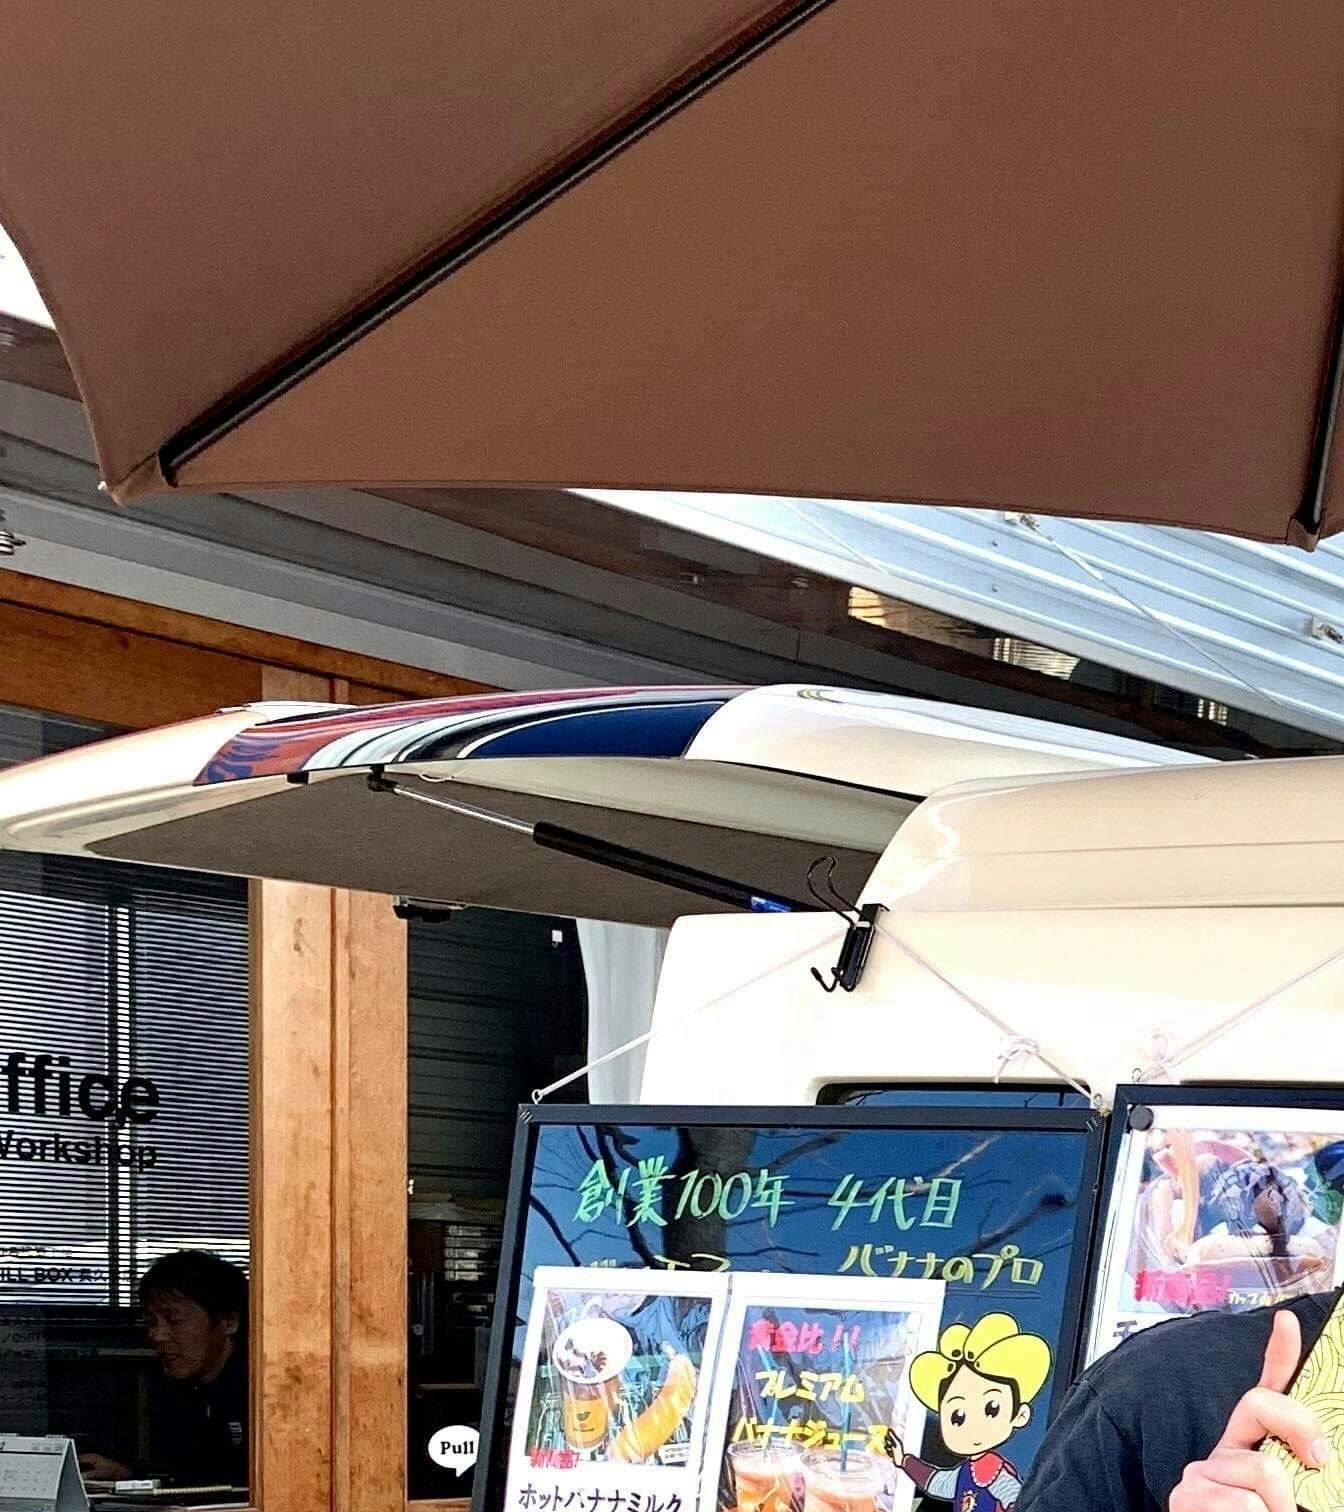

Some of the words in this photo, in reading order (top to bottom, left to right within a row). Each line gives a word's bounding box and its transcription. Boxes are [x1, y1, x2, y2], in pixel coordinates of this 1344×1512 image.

[572, 1156, 796, 1228] 創業100年
[829, 1173, 963, 1232] 4代目
[838, 1243, 1044, 1291] バナナのプロ
[440, 1440, 474, 1455] Pull
